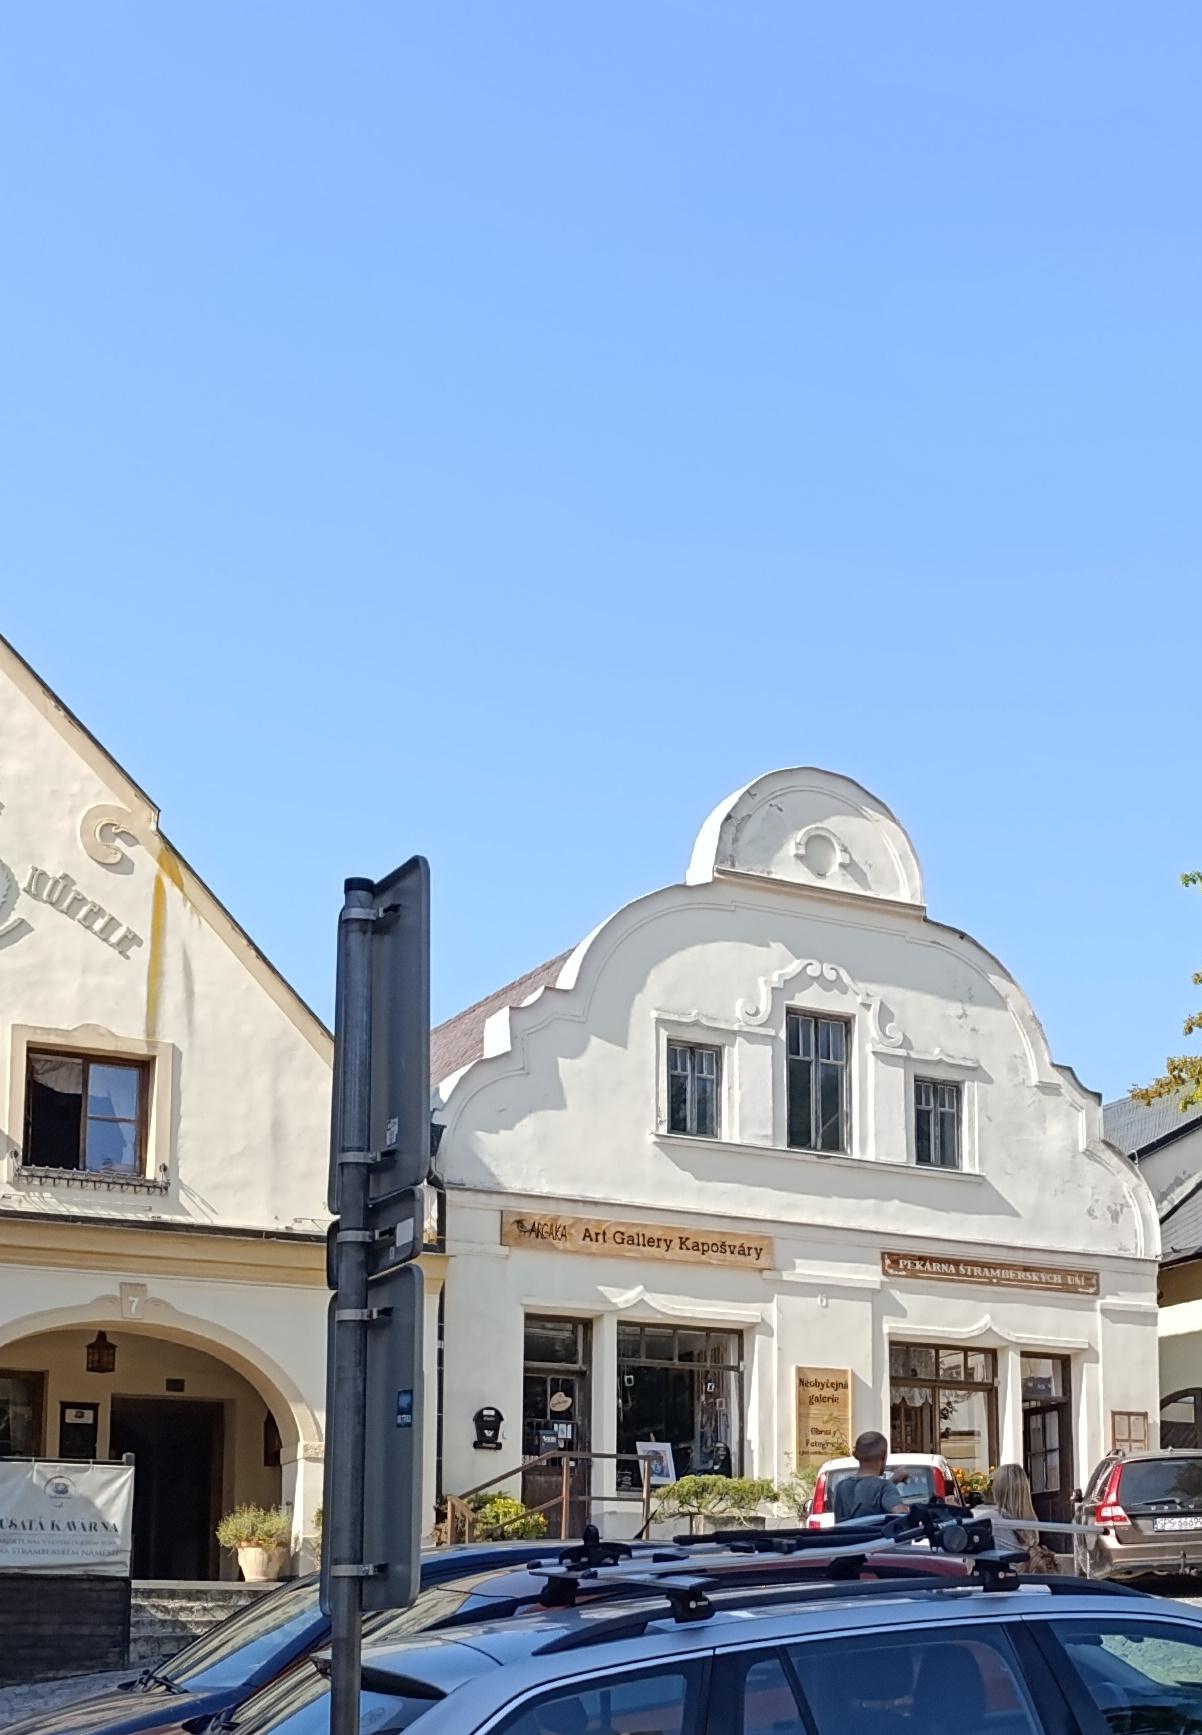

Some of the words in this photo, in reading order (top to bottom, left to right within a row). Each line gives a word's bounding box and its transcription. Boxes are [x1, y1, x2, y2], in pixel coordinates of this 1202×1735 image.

[582, 1228, 607, 1243] Art
[613, 1230, 673, 1252] Gallery
[678, 1236, 763, 1261] Kapošváry
[898, 1259, 956, 1274] PEKÁRNA
[128, 1296, 139, 1314] 7
